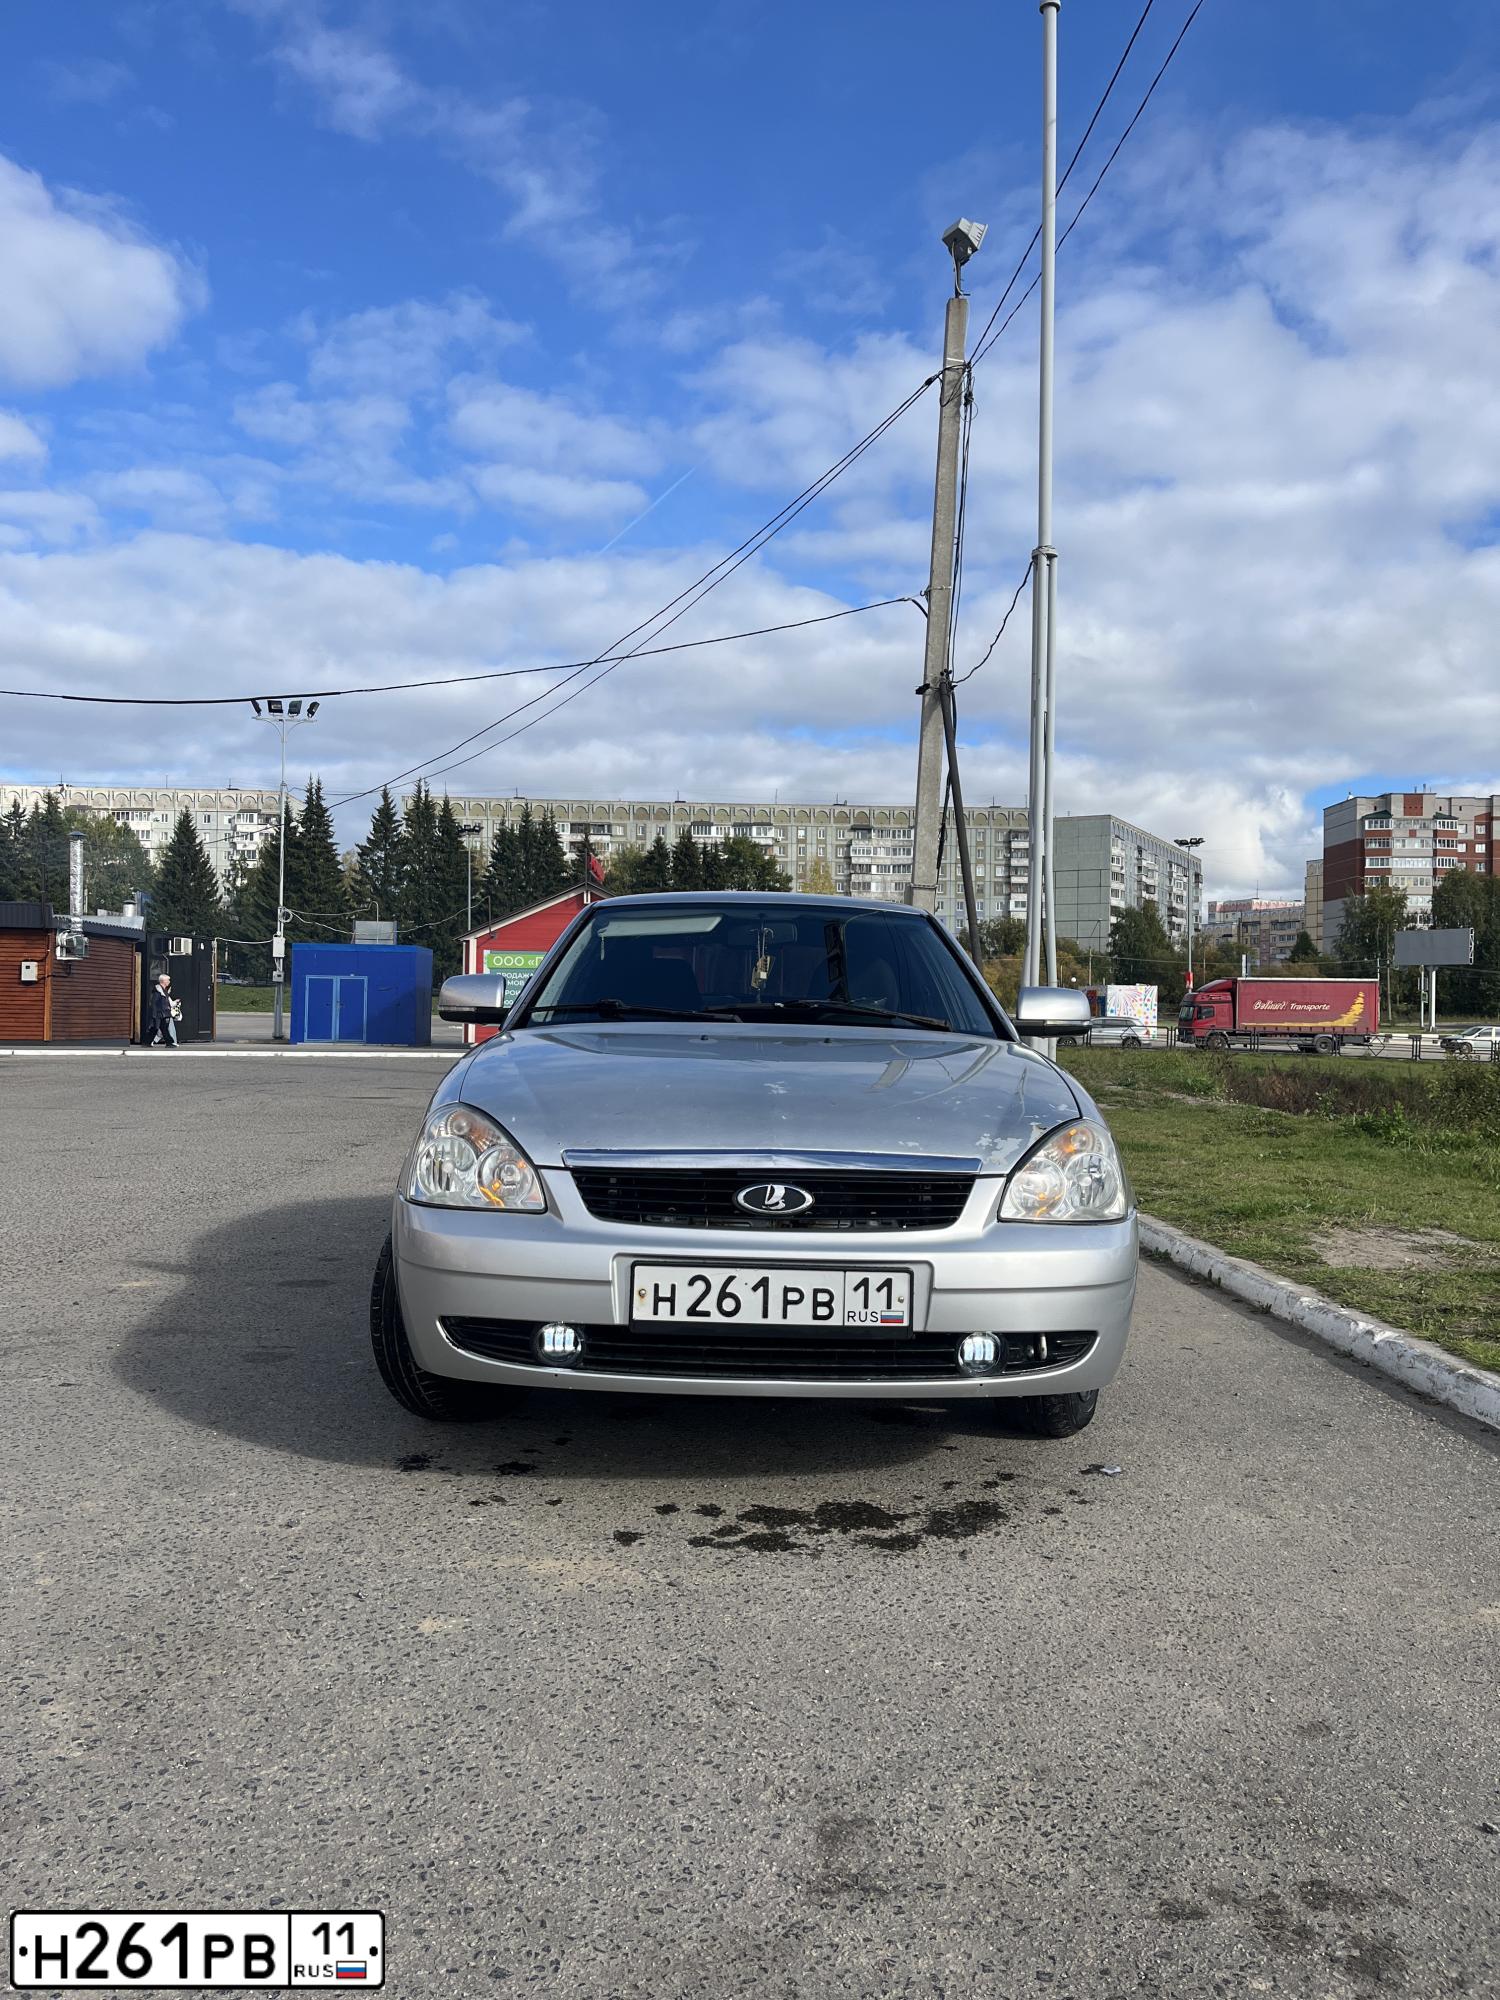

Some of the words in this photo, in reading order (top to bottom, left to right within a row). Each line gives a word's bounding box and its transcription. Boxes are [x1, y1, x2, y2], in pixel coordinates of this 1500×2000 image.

[493, 956, 524, 966] ООО
[1290, 1002, 1331, 1012] Transporte
[652, 1274, 835, 1321] Н261РВ
[853, 1277, 893, 1310] 11
[847, 1311, 879, 1323] RUS
